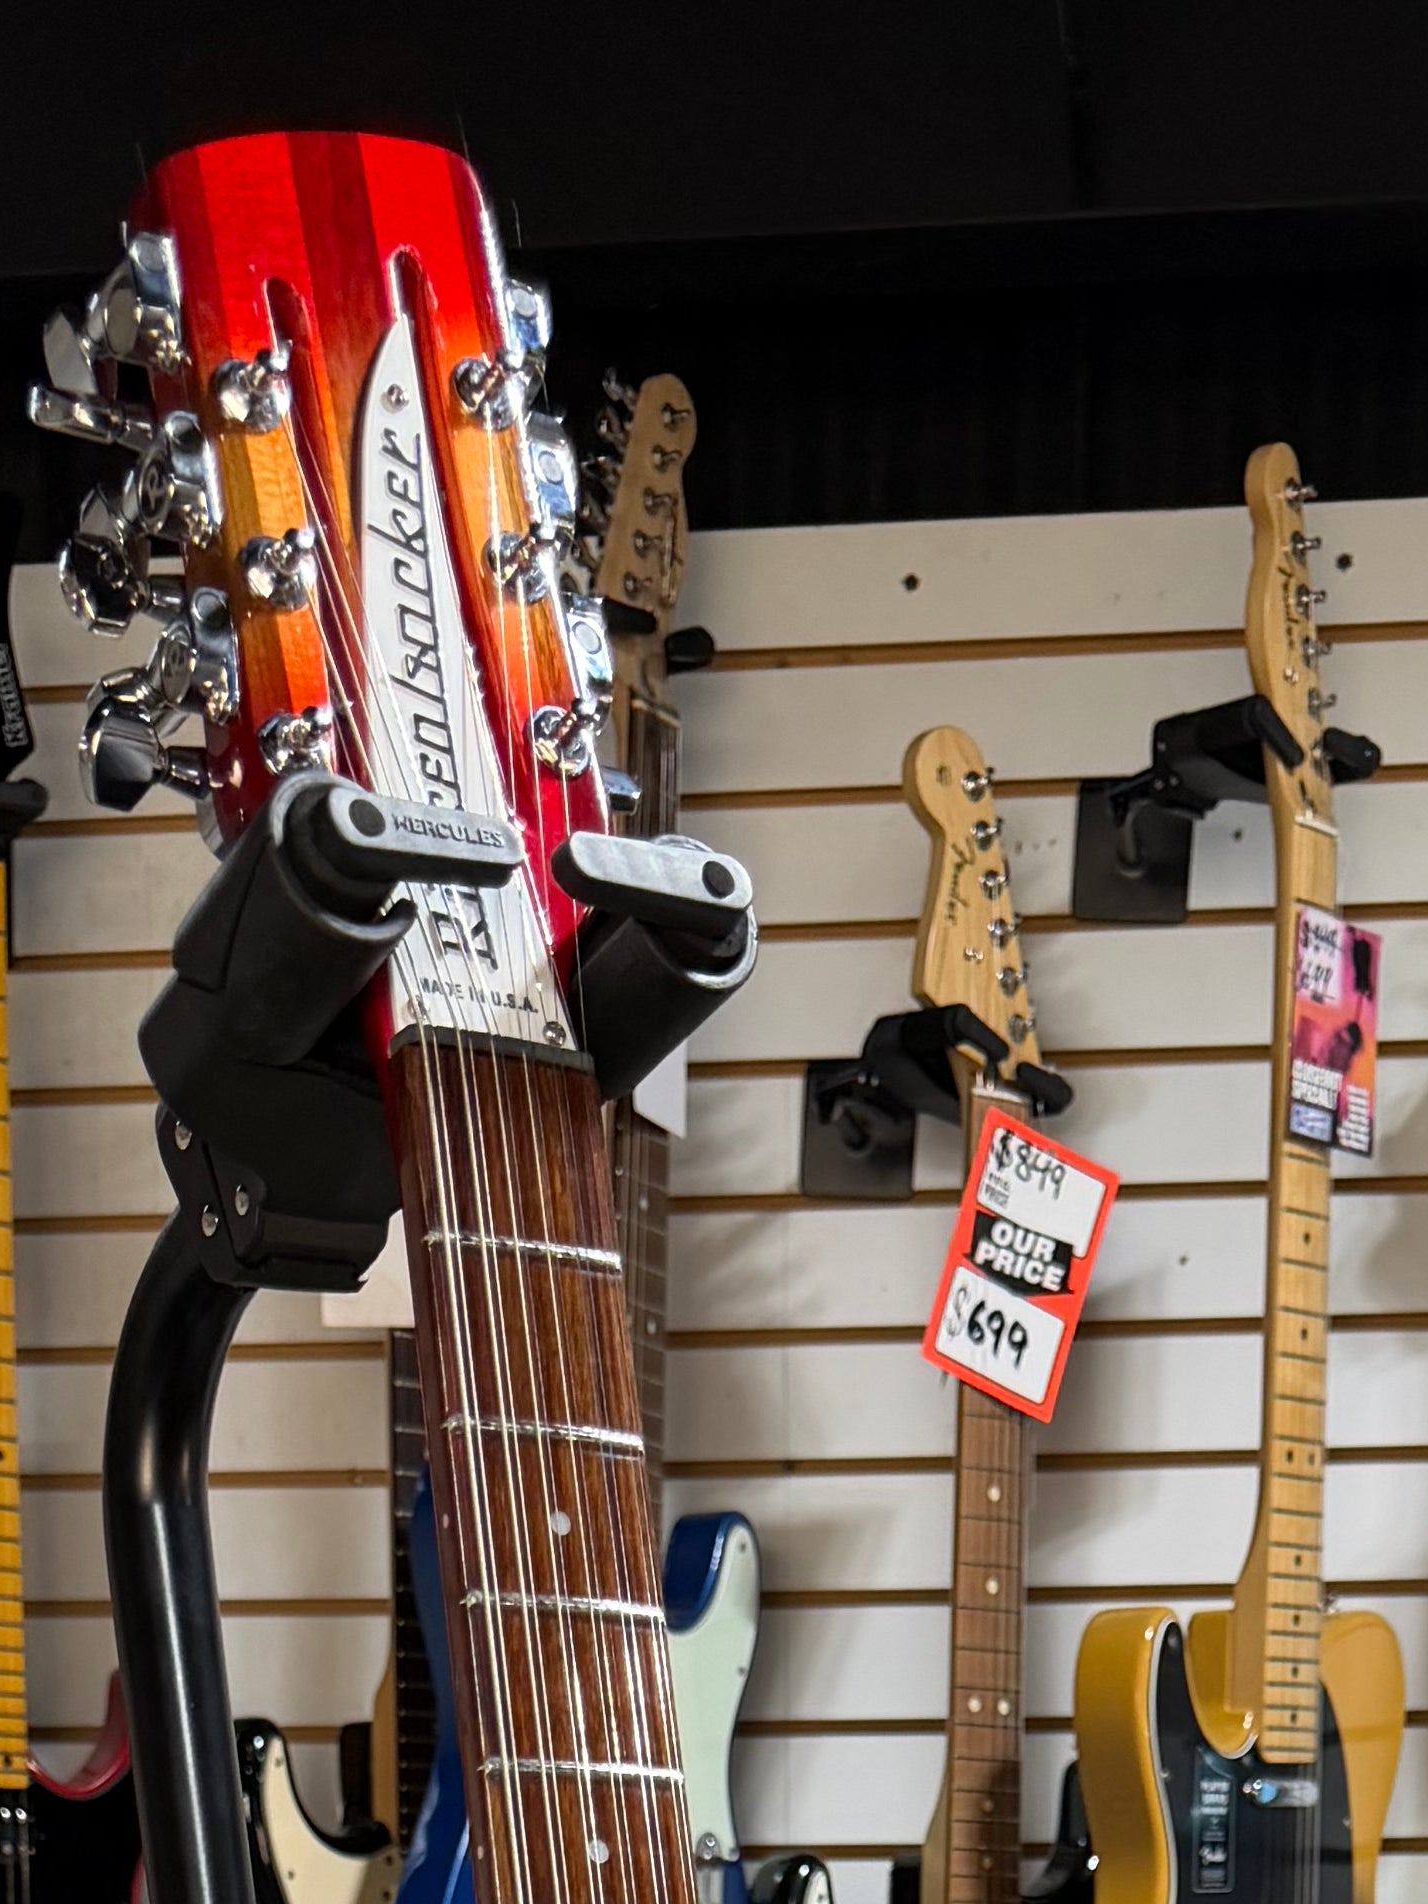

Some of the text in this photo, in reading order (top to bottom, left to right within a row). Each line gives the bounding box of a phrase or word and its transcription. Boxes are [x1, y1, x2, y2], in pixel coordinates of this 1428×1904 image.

[392, 813, 505, 849] HERCULES
[991, 1220, 1057, 1262] OUR
[974, 1241, 1066, 1293] PRICE
[946, 1284, 1029, 1369] $699
